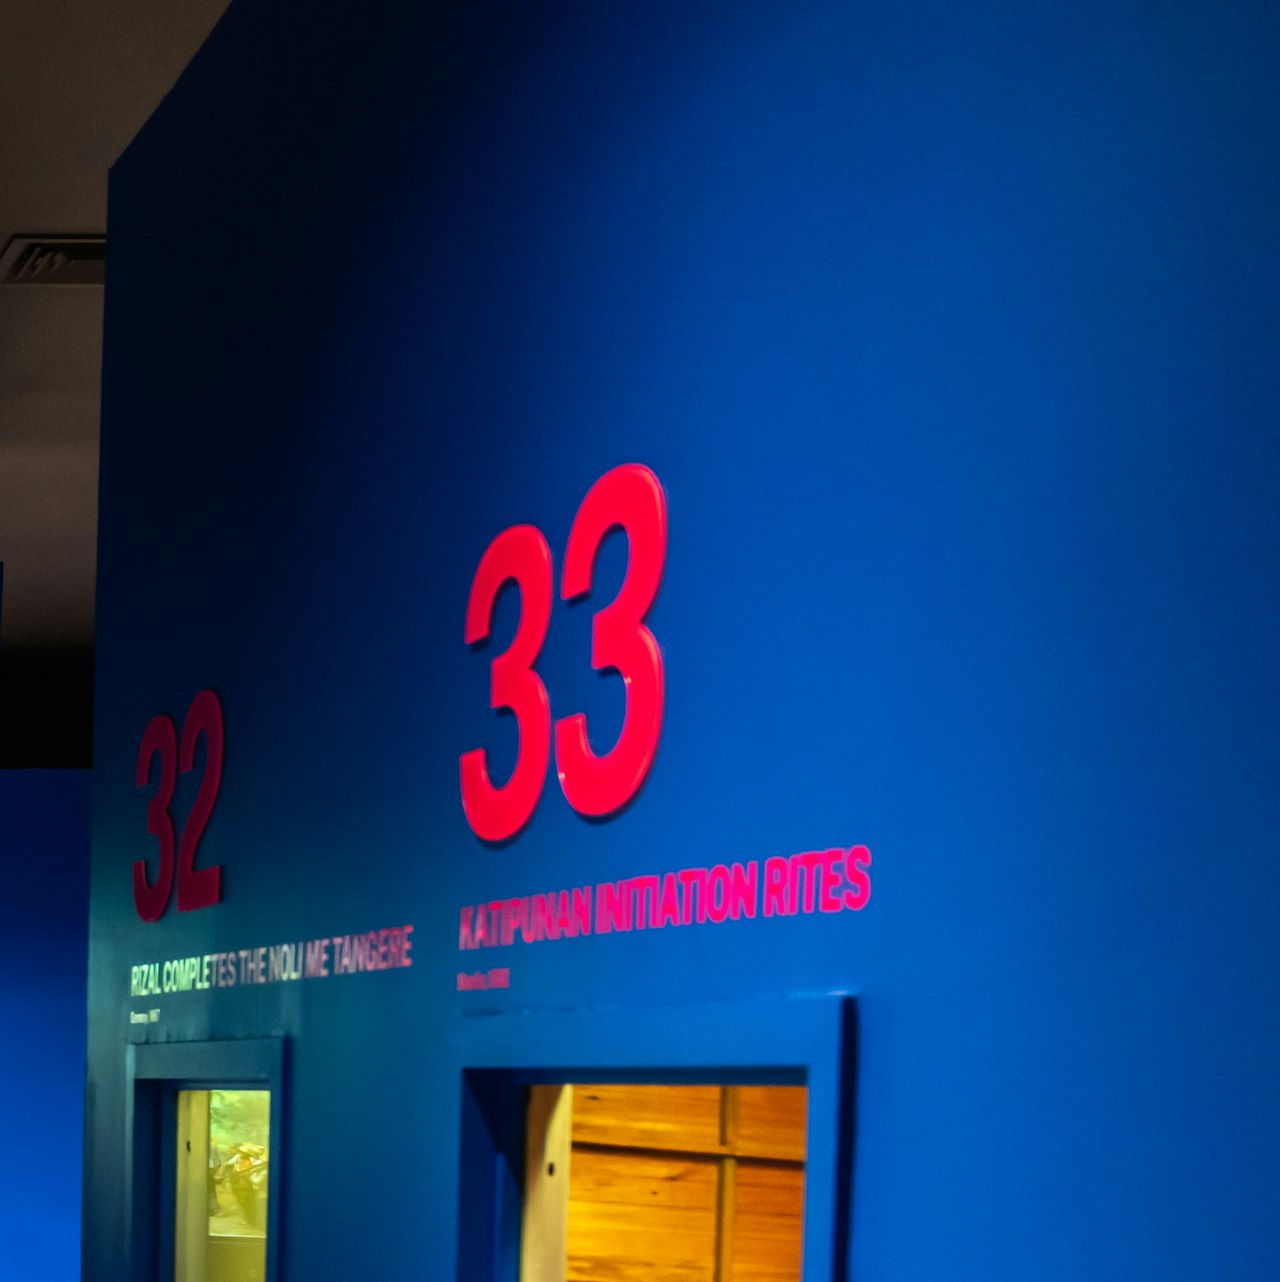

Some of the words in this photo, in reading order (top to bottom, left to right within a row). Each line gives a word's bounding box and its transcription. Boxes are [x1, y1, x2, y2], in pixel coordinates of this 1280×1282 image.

[460, 462, 667, 841] 33
[132, 688, 224, 922] 32
[131, 964, 161, 996] RIZAL
[162, 952, 236, 993] COMPLETES
[239, 947, 266, 985] THE
[268, 942, 302, 982] NOLI
[304, 938, 329, 979] ME
[332, 924, 414, 976] TANGERE
[458, 885, 592, 951] KATIPUNAN
[595, 861, 759, 935] INITIATION
[764, 844, 871, 917] RITES
